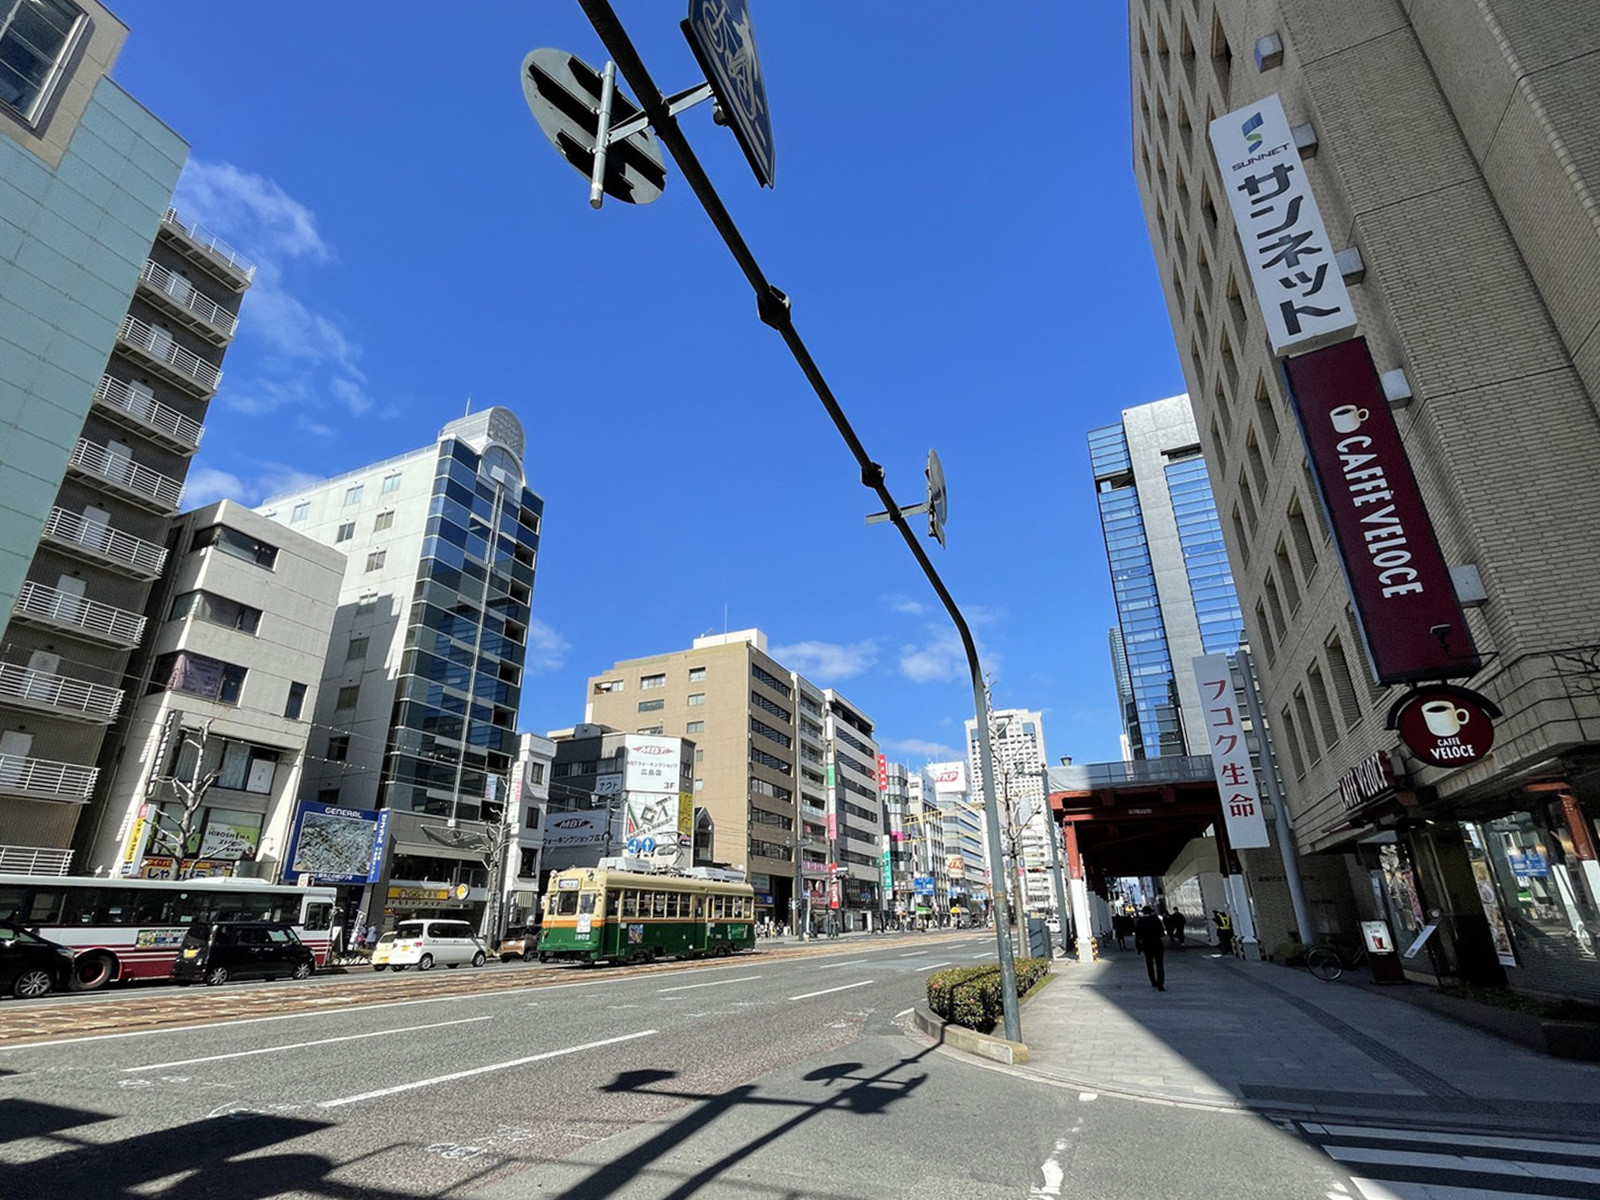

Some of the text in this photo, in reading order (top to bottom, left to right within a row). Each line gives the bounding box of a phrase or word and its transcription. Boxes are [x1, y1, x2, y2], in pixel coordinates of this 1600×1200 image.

[1232, 142, 1290, 172] SUNNET
[1237, 163, 1341, 336] サンネット
[1360, 504, 1424, 599] VELOCE
[1203, 679, 1255, 817] フコク生命
[1430, 744, 1476, 760] VELOCE
[664, 781, 676, 789] 3F
[1354, 752, 1388, 797] VELOCE
[325, 806, 363, 819] GENERAL
[559, 818, 586, 830] MBT
